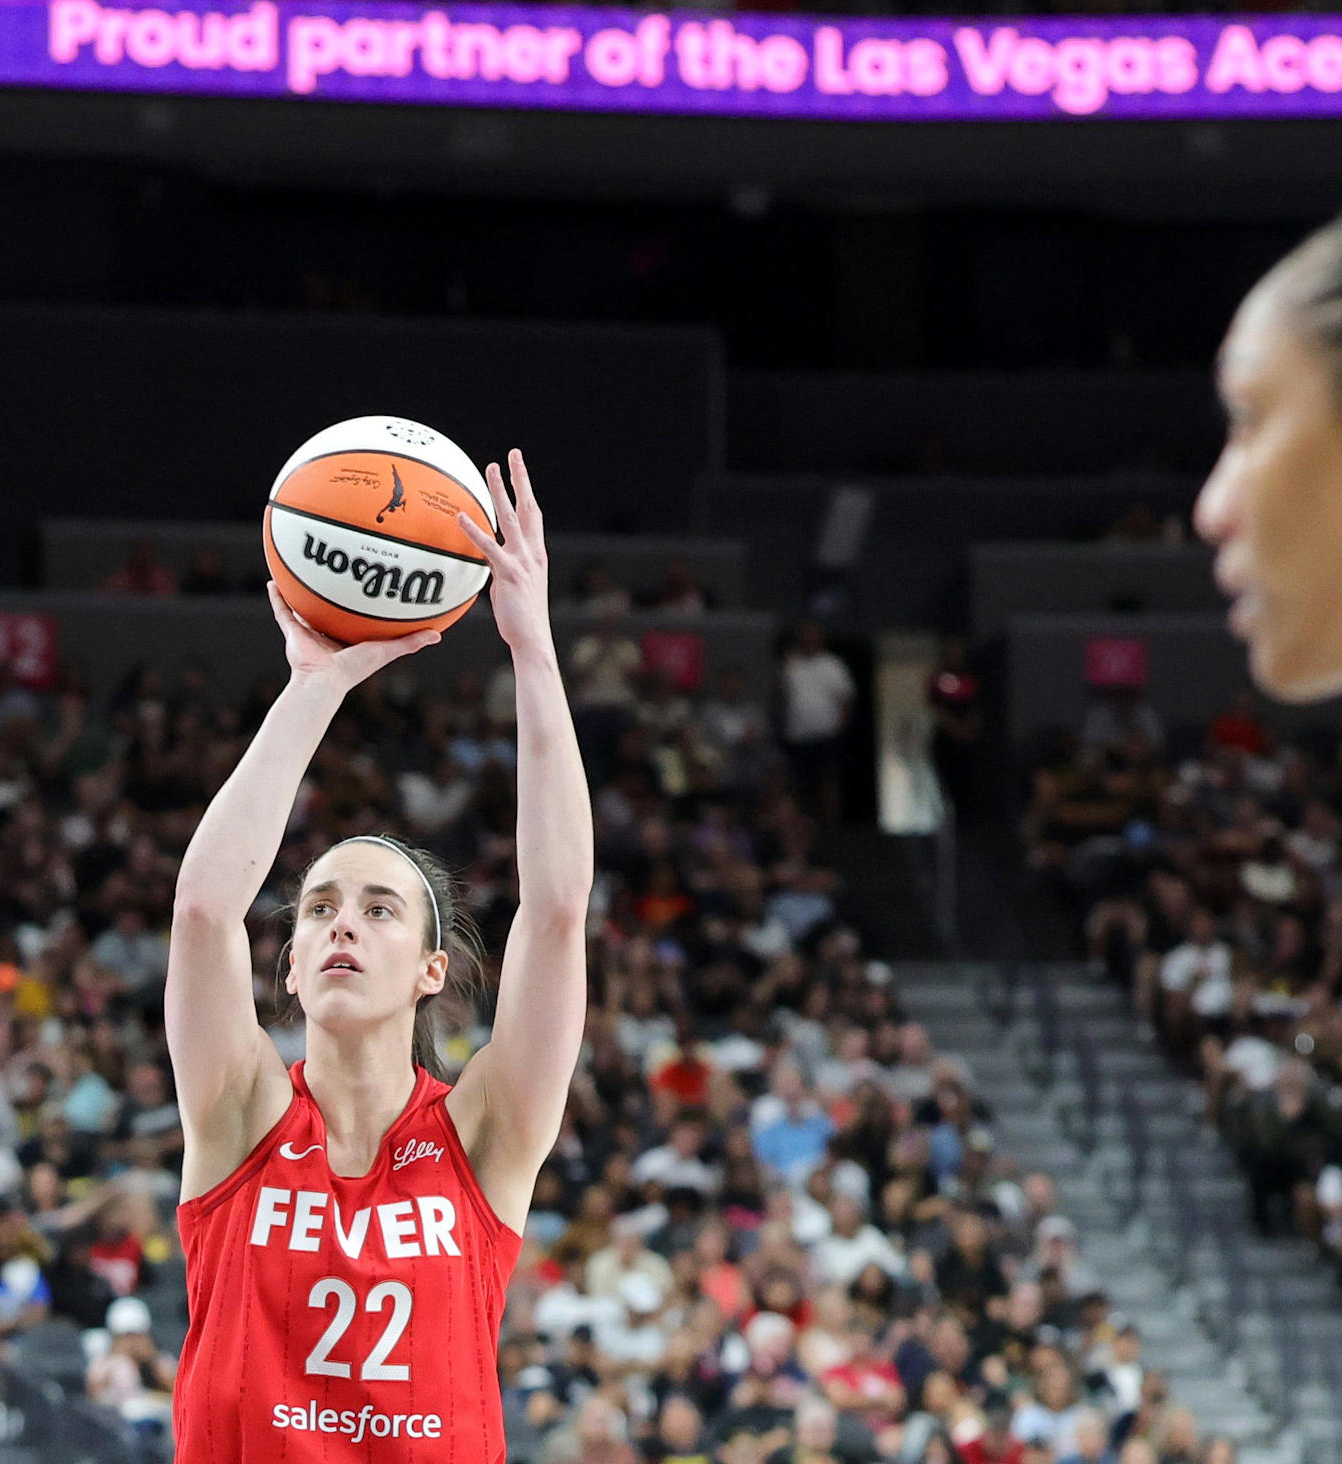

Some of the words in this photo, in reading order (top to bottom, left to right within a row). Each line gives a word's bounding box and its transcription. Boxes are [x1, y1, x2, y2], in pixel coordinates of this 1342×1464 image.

[50, 0, 277, 71] Proud
[288, 12, 580, 94] partner
[585, 14, 671, 87] of
[675, 20, 808, 93] the
[815, 26, 948, 95] Las
[956, 27, 1198, 115] Vegas
[304, 533, 444, 605] Wilson
[393, 1138, 445, 1171] Lilly
[250, 1186, 462, 1259] FEVER
[304, 1276, 413, 1382] 22
[272, 1400, 442, 1443] salesforce
